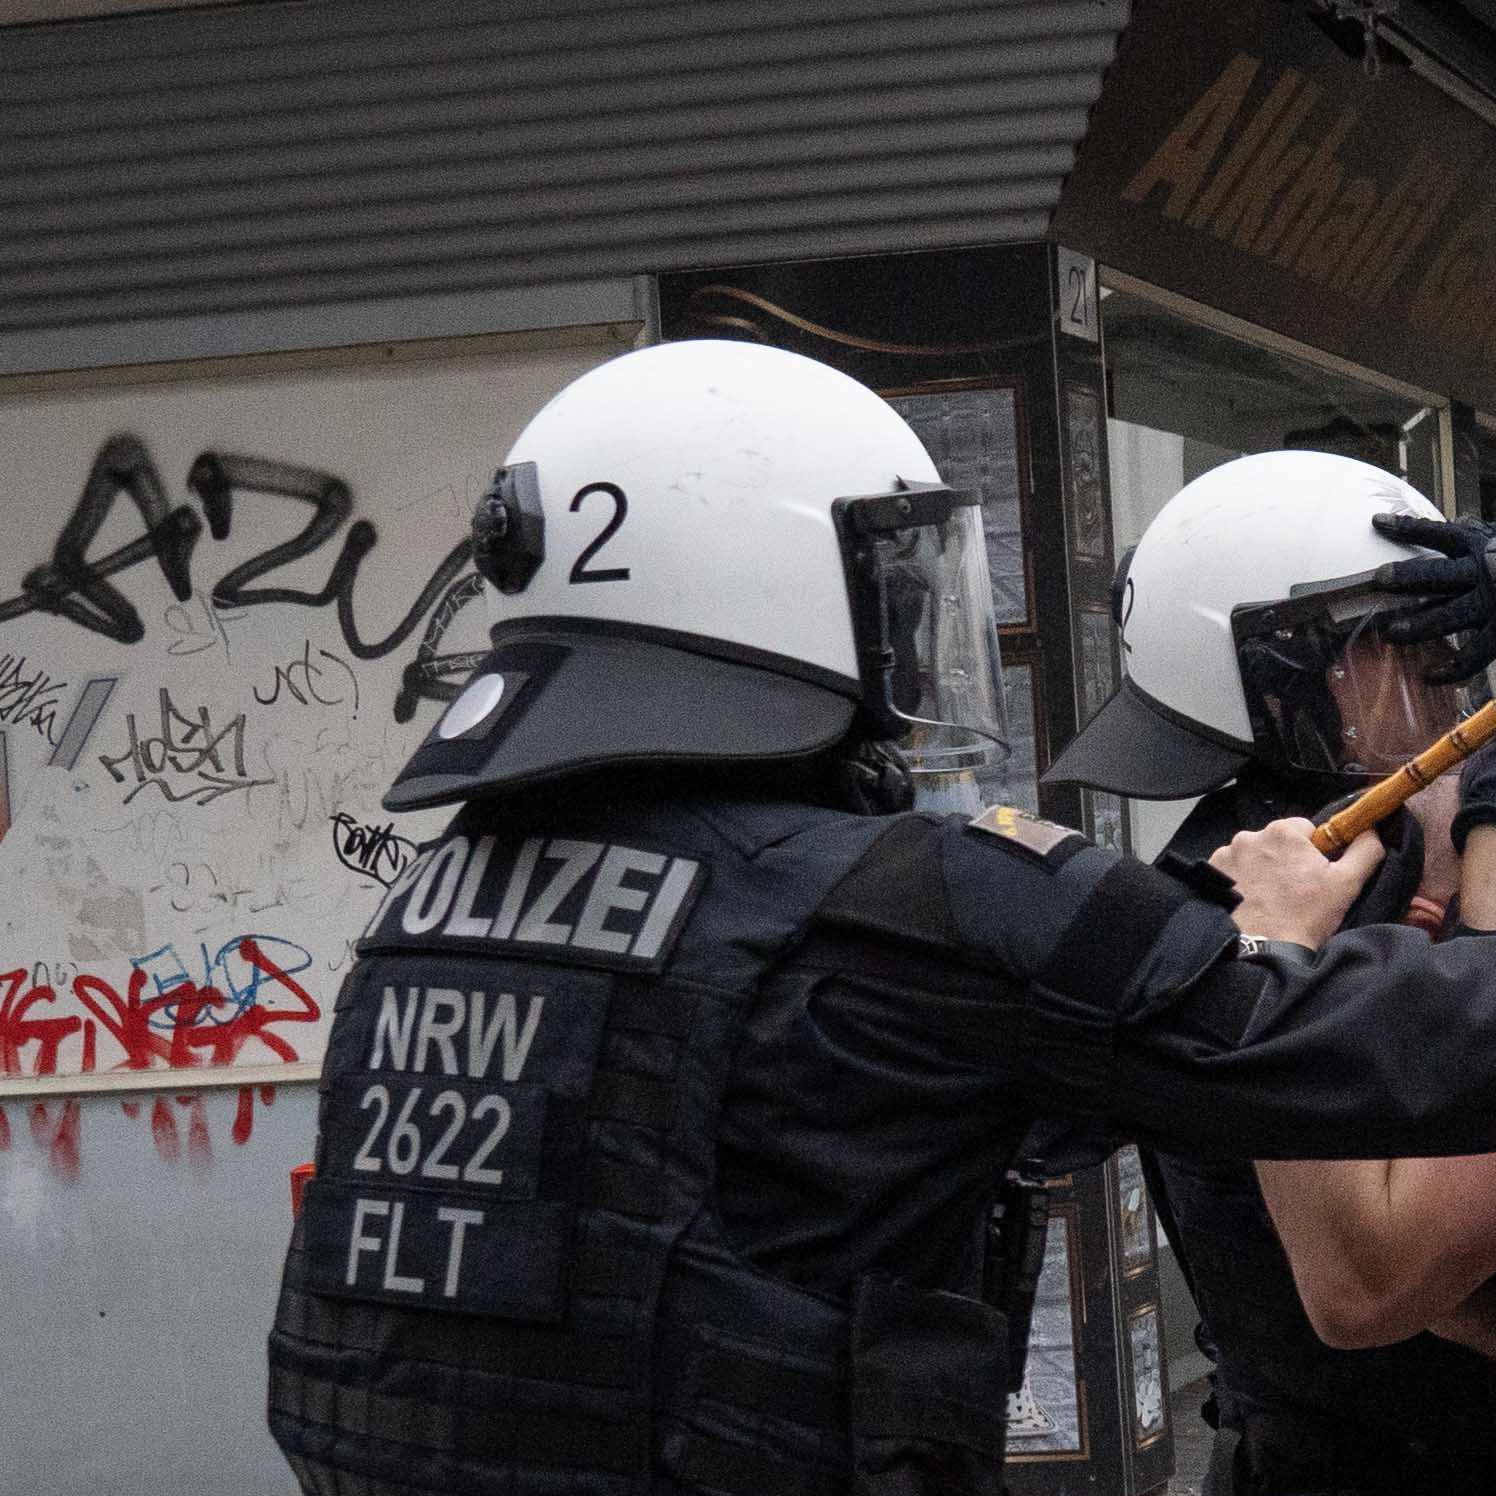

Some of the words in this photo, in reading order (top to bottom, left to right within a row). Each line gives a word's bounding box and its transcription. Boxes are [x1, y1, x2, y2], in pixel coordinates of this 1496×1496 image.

[568, 481, 631, 585] 2
[366, 836, 701, 960] POLIZEI
[368, 985, 545, 1082] NRW
[353, 1084, 512, 1185] 2622
